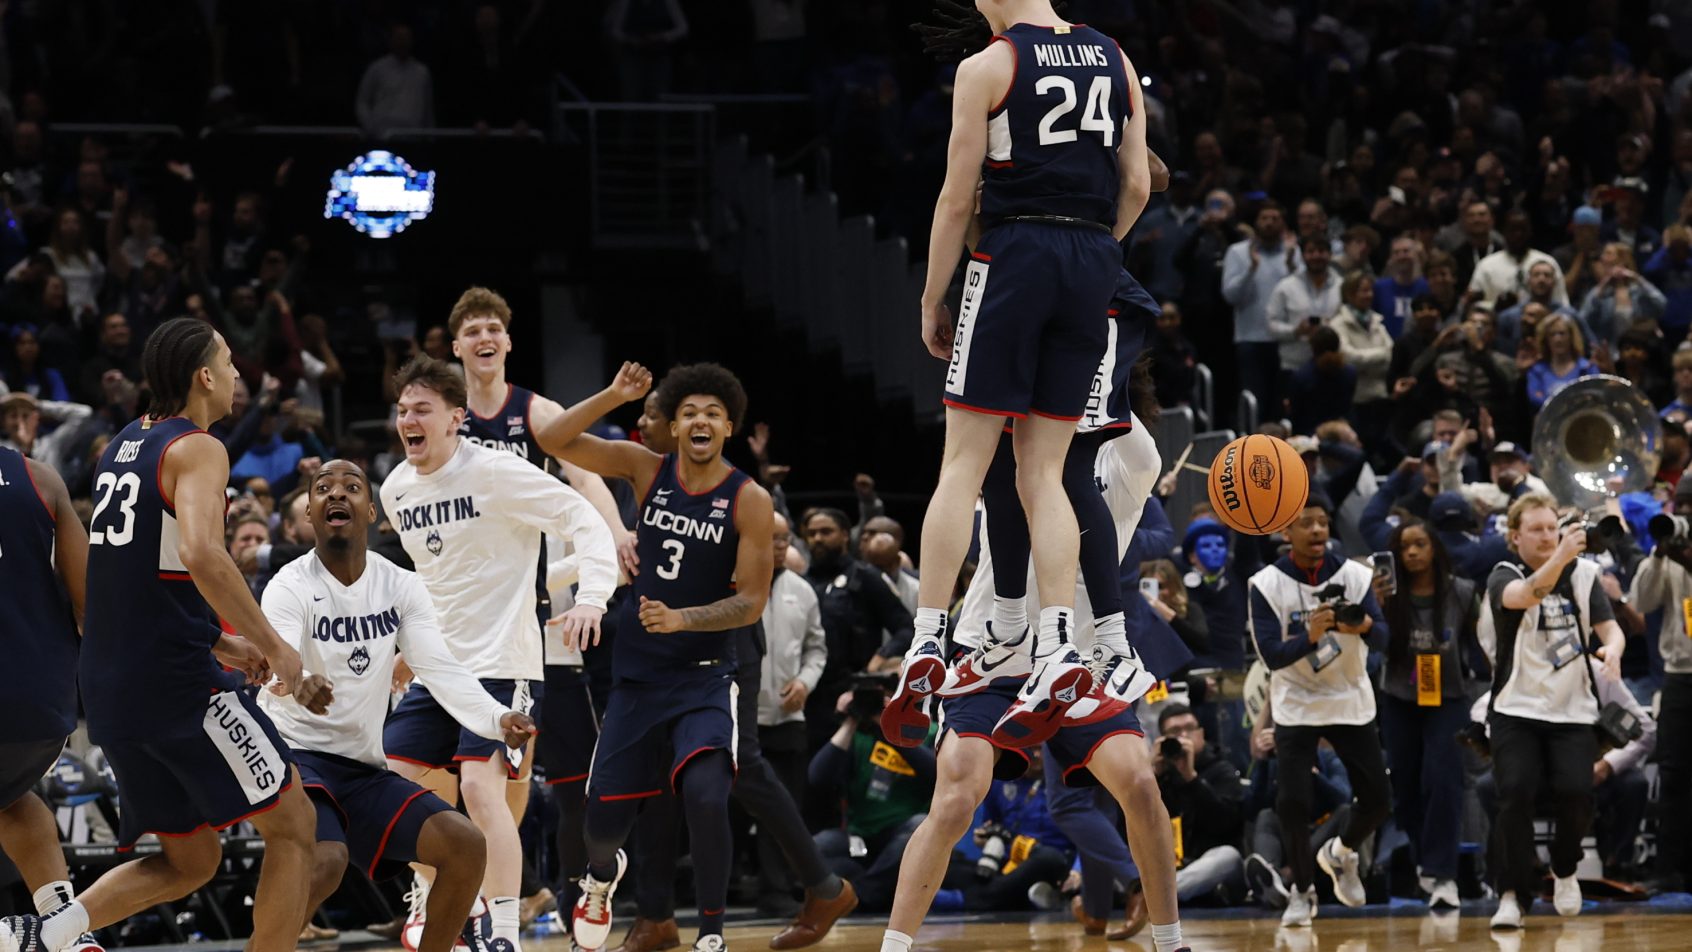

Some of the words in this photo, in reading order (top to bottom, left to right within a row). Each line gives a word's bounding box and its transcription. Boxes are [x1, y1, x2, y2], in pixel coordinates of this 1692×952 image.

[1033, 43, 1108, 67] MULLINS
[1035, 75, 1114, 147] 24
[946, 270, 981, 385] HUSKIES
[1219, 446, 1241, 511] Wilson
[89, 472, 141, 546] 23
[435, 500, 451, 525] IT
[453, 495, 481, 521] IN.
[643, 505, 724, 544] UCONN
[656, 538, 685, 580] 3
[359, 613, 378, 641] IT
[208, 696, 276, 791] HUSKIES
